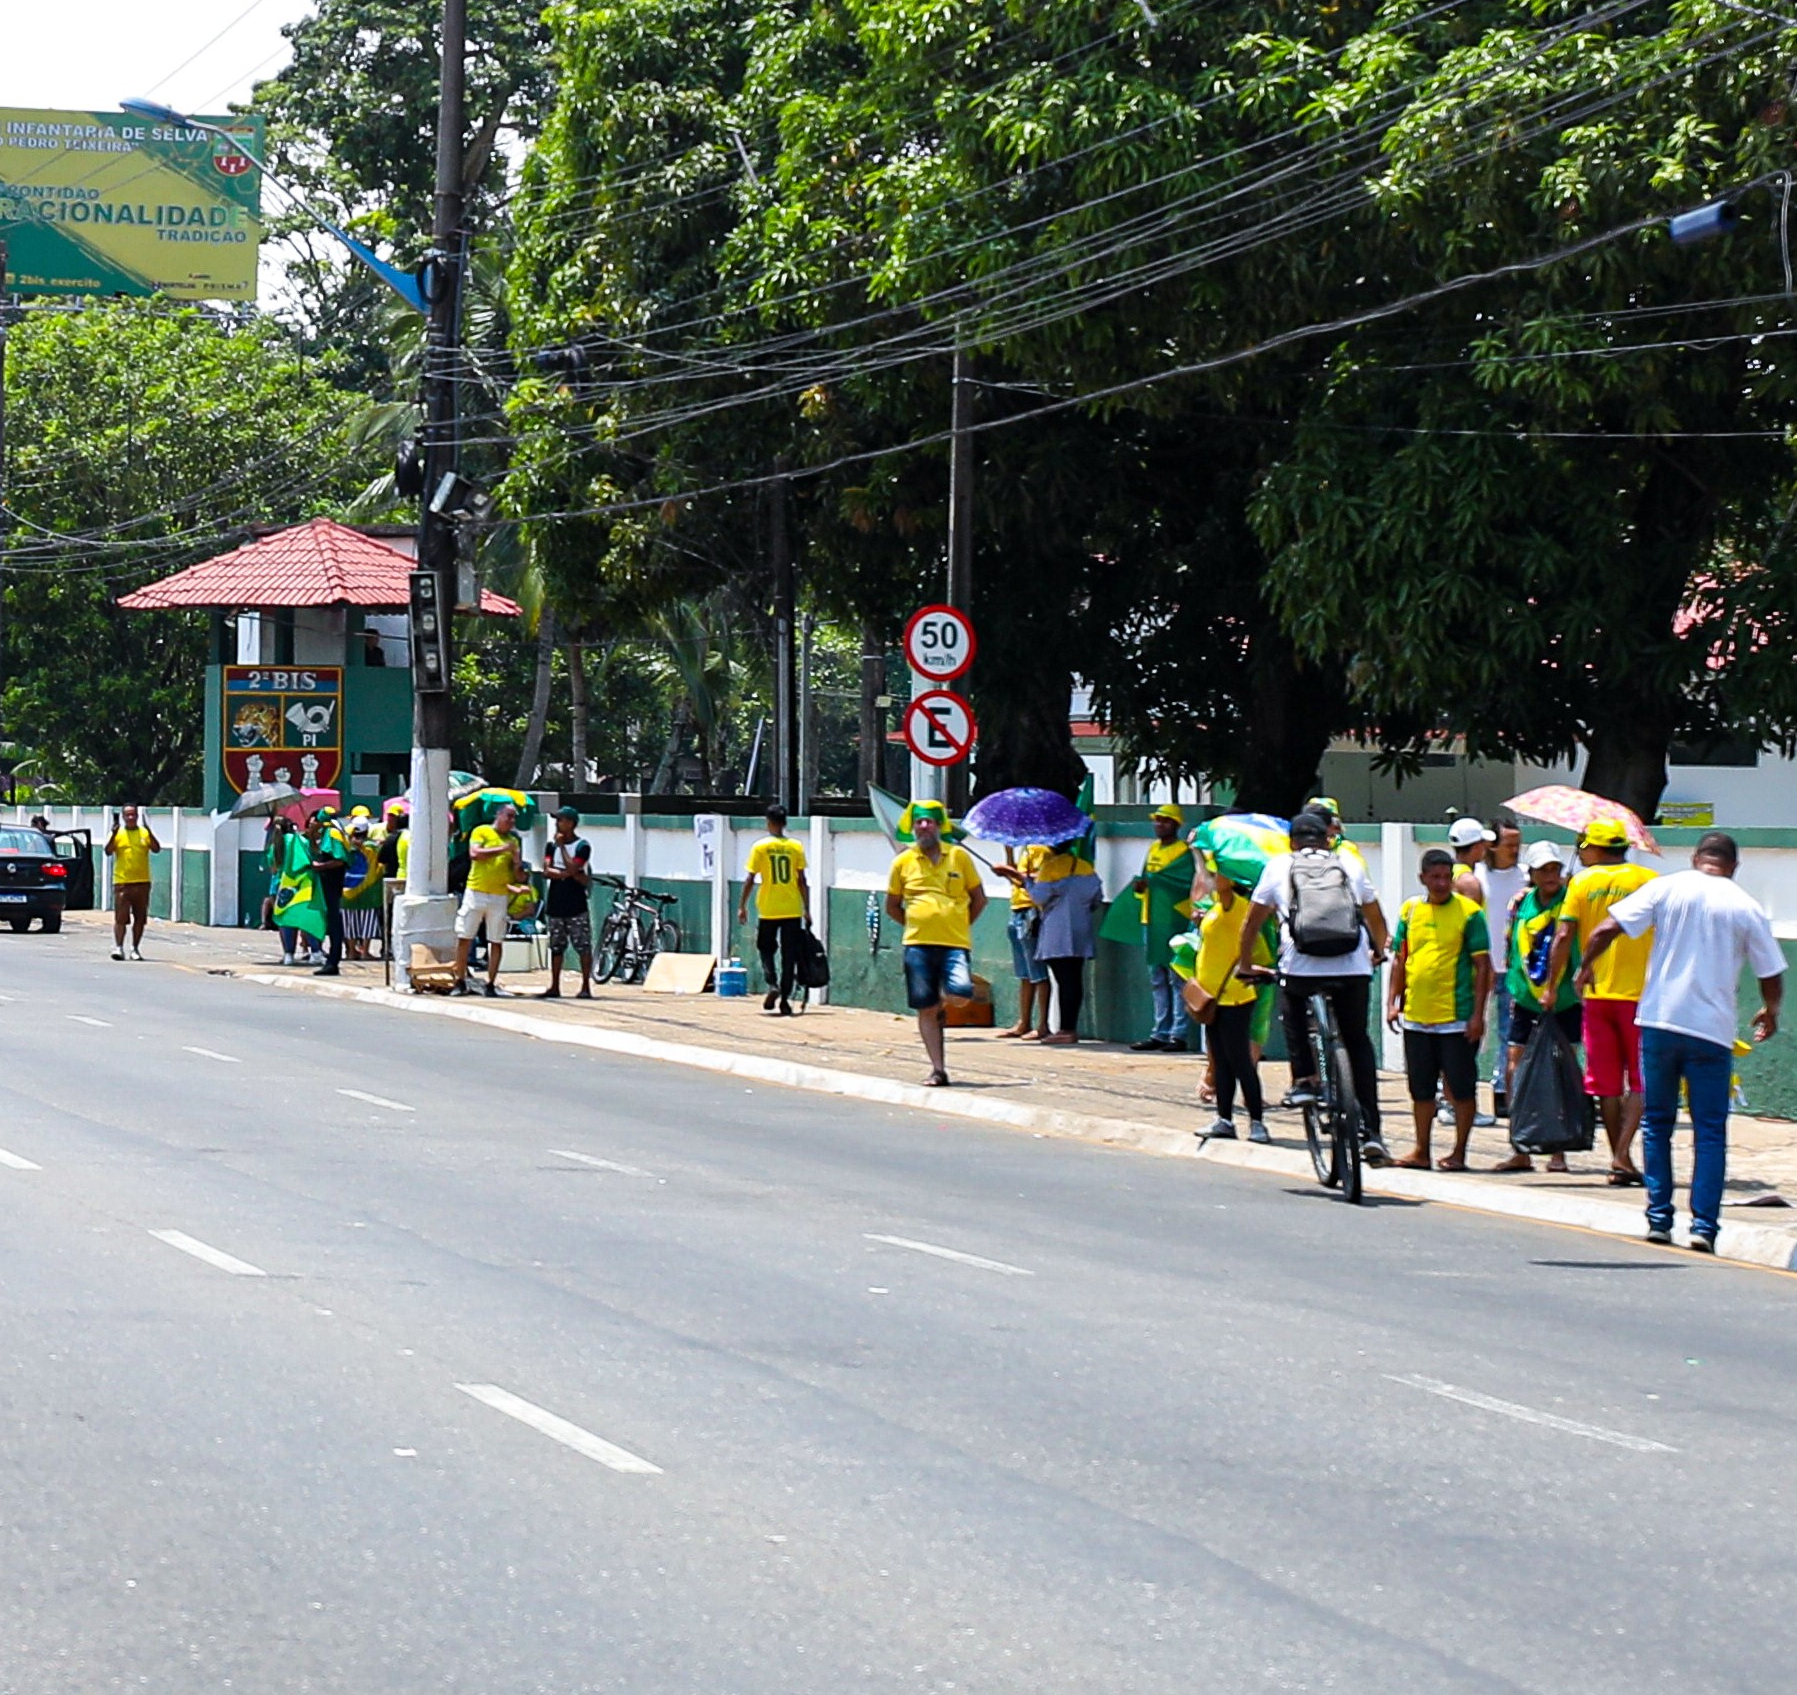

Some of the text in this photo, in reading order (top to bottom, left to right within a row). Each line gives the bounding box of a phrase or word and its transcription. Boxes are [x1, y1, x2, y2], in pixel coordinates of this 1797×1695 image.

[6, 121, 116, 140] INFANTARIA
[121, 126, 146, 141] DE
[152, 128, 209, 143] SELVA
[8, 136, 59, 149] PEDRO
[920, 621, 958, 650] 50
[923, 652, 957, 667] km/h
[272, 672, 317, 691] BIS
[927, 706, 953, 749] E
[302, 733, 317, 747] PI
[769, 855, 792, 885] 10
